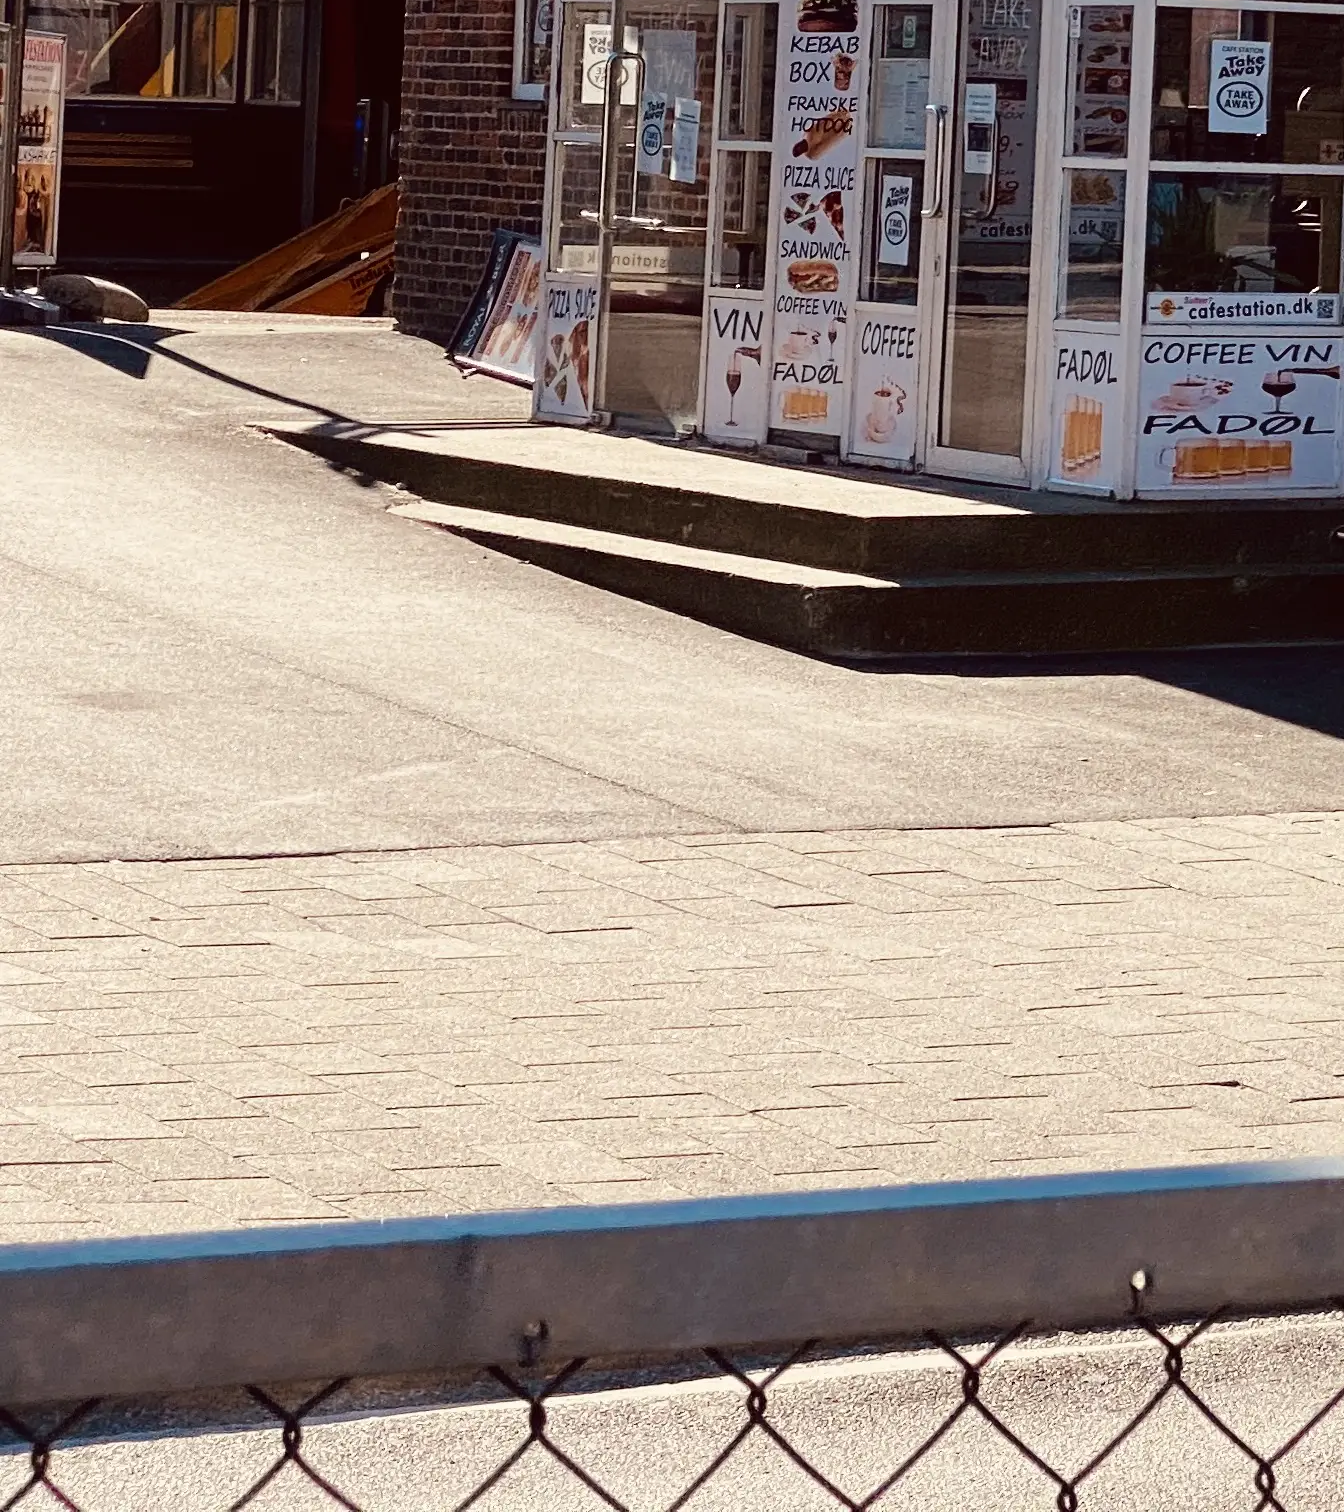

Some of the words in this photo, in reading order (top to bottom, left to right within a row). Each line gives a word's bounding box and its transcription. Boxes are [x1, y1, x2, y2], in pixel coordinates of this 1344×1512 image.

[790, 35, 860, 54] KEBAB
[789, 61, 831, 83] BOX
[1218, 64, 1266, 80] Away
[1225, 55, 1266, 69] Take
[788, 96, 858, 112] FRANSKE
[1224, 99, 1256, 109] AWAY
[1227, 89, 1255, 100] TAKE
[791, 116, 853, 135] HOTDOG
[784, 165, 821, 190] PIZZA
[824, 166, 855, 191] SLICE
[780, 240, 851, 262] SANDWICH
[549, 287, 571, 321] PIZZA
[574, 285, 597, 320] SLICE
[776, 294, 820, 315] COFFEE
[823, 299, 847, 316] VIN
[1188, 297, 1313, 319] cafestation.dk
[713, 308, 763, 342] VIN
[861, 321, 916, 359] COFFEE
[1144, 341, 1256, 365] COFFEE
[1266, 344, 1333, 363] VIN
[773, 360, 844, 385] FADØL
[1057, 348, 1118, 384] FADØL
[1142, 414, 1336, 436] FADØL
